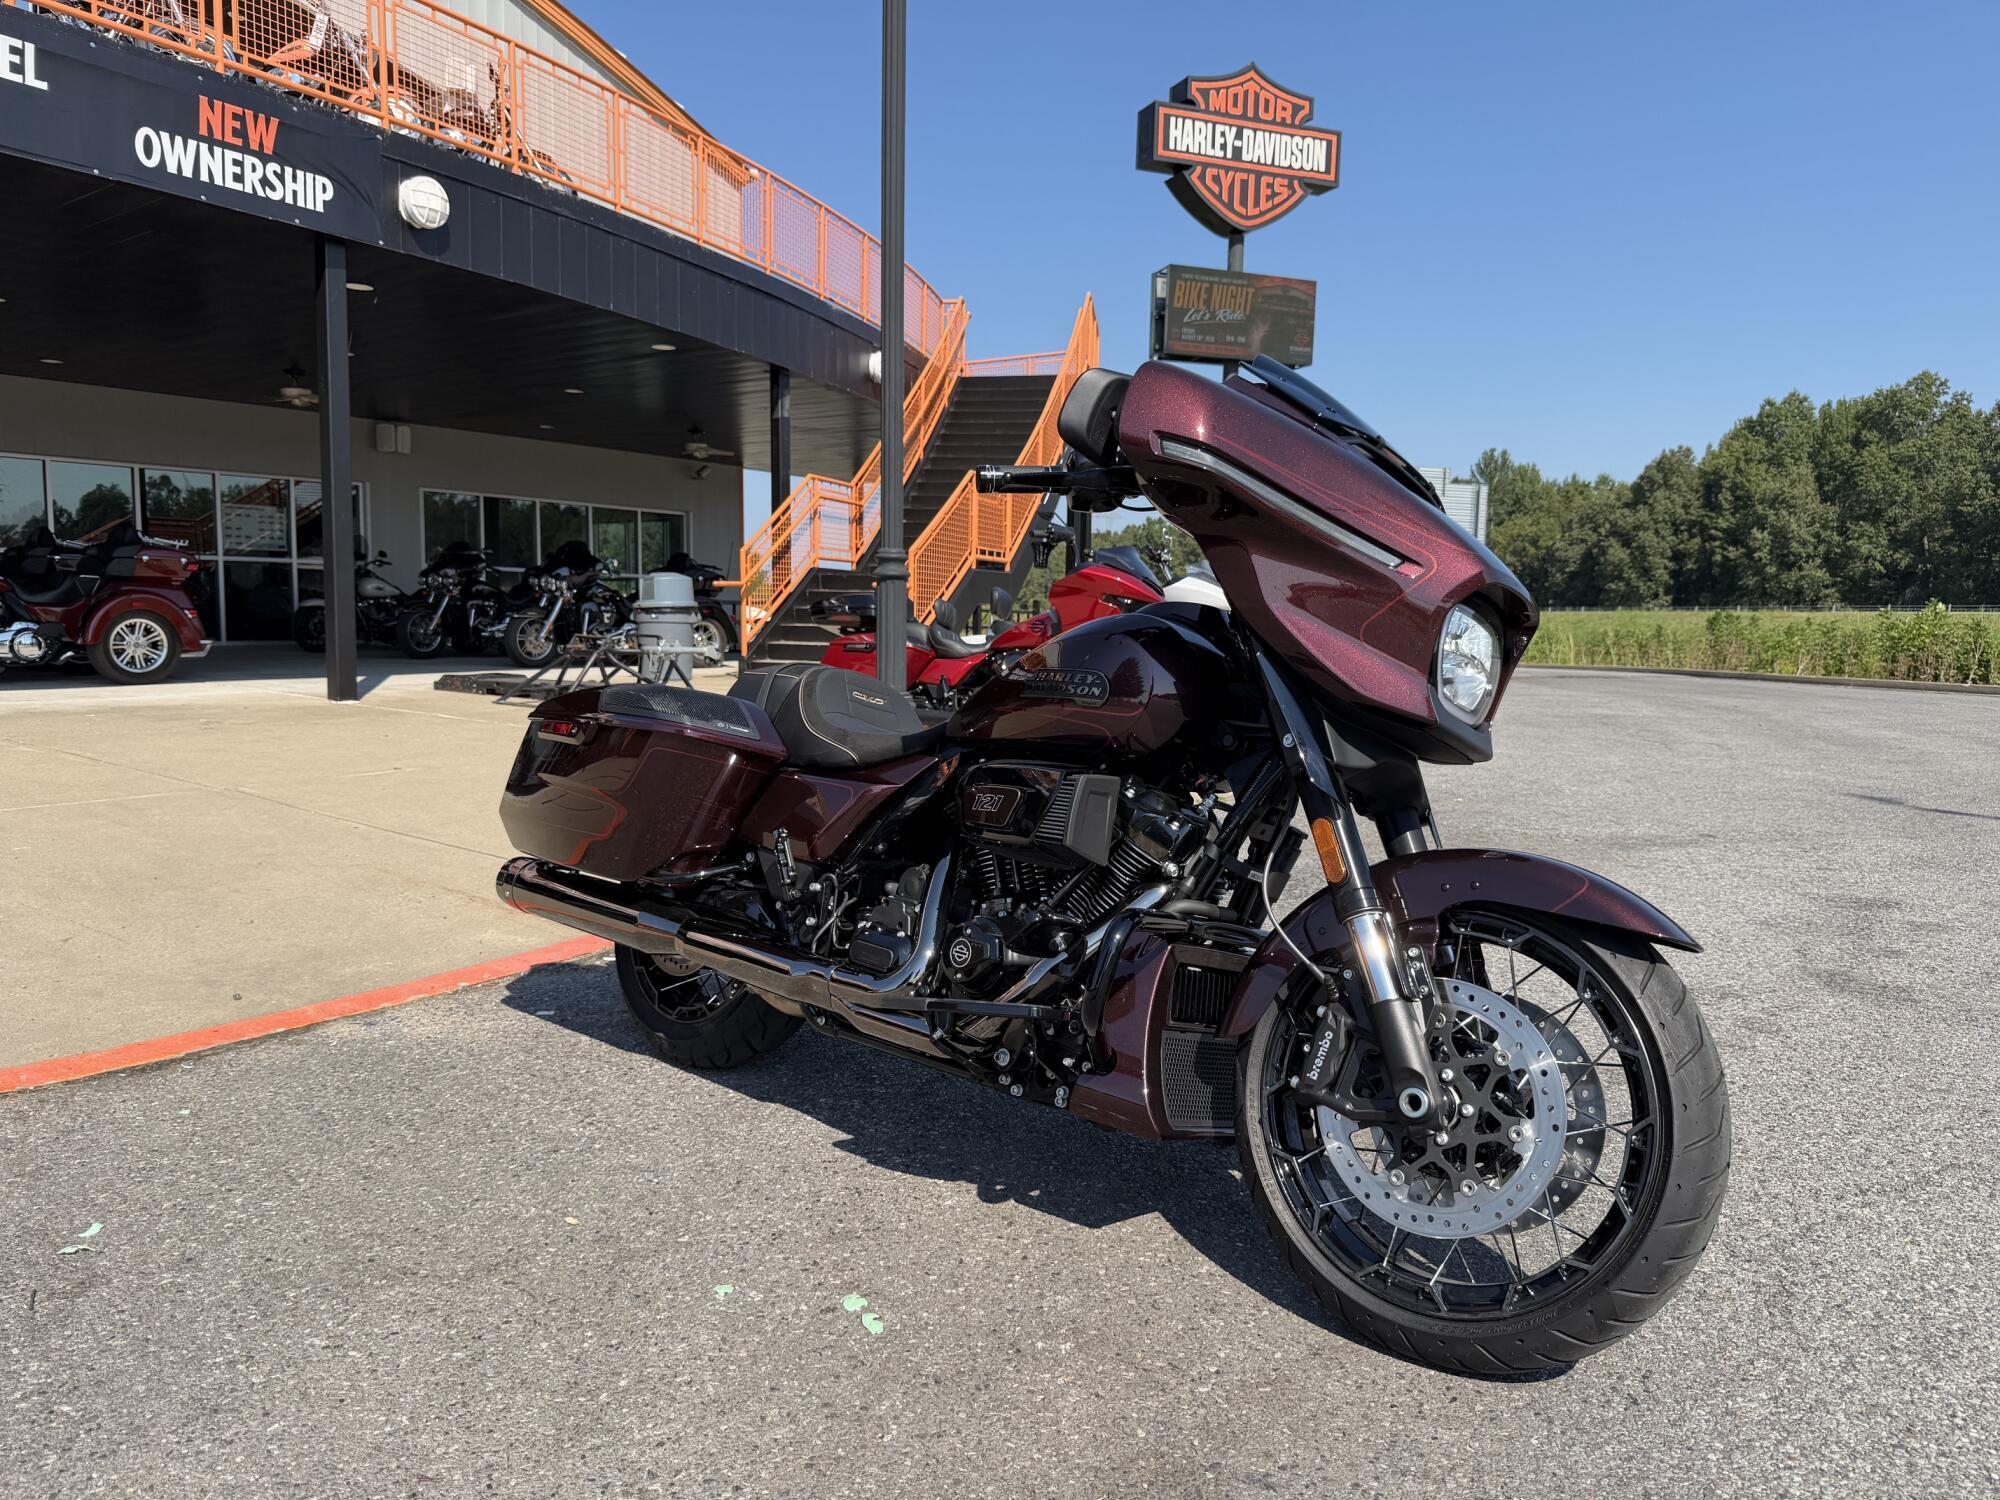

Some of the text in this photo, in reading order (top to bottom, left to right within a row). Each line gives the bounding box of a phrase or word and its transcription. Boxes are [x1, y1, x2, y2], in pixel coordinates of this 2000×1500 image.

[198, 95, 279, 155] NEW
[1209, 80, 1292, 125] MOTOR
[1168, 116, 1327, 173] HARLEY-DAVIDSON
[134, 126, 334, 213] OWNERSHIP
[1205, 168, 1289, 216] CYCLES
[1173, 280, 1255, 315] BIKE NIGHT
[1184, 309, 1210, 322] Let's
[972, 793, 1005, 811] 121
[1306, 1030, 1334, 1081] brembo
